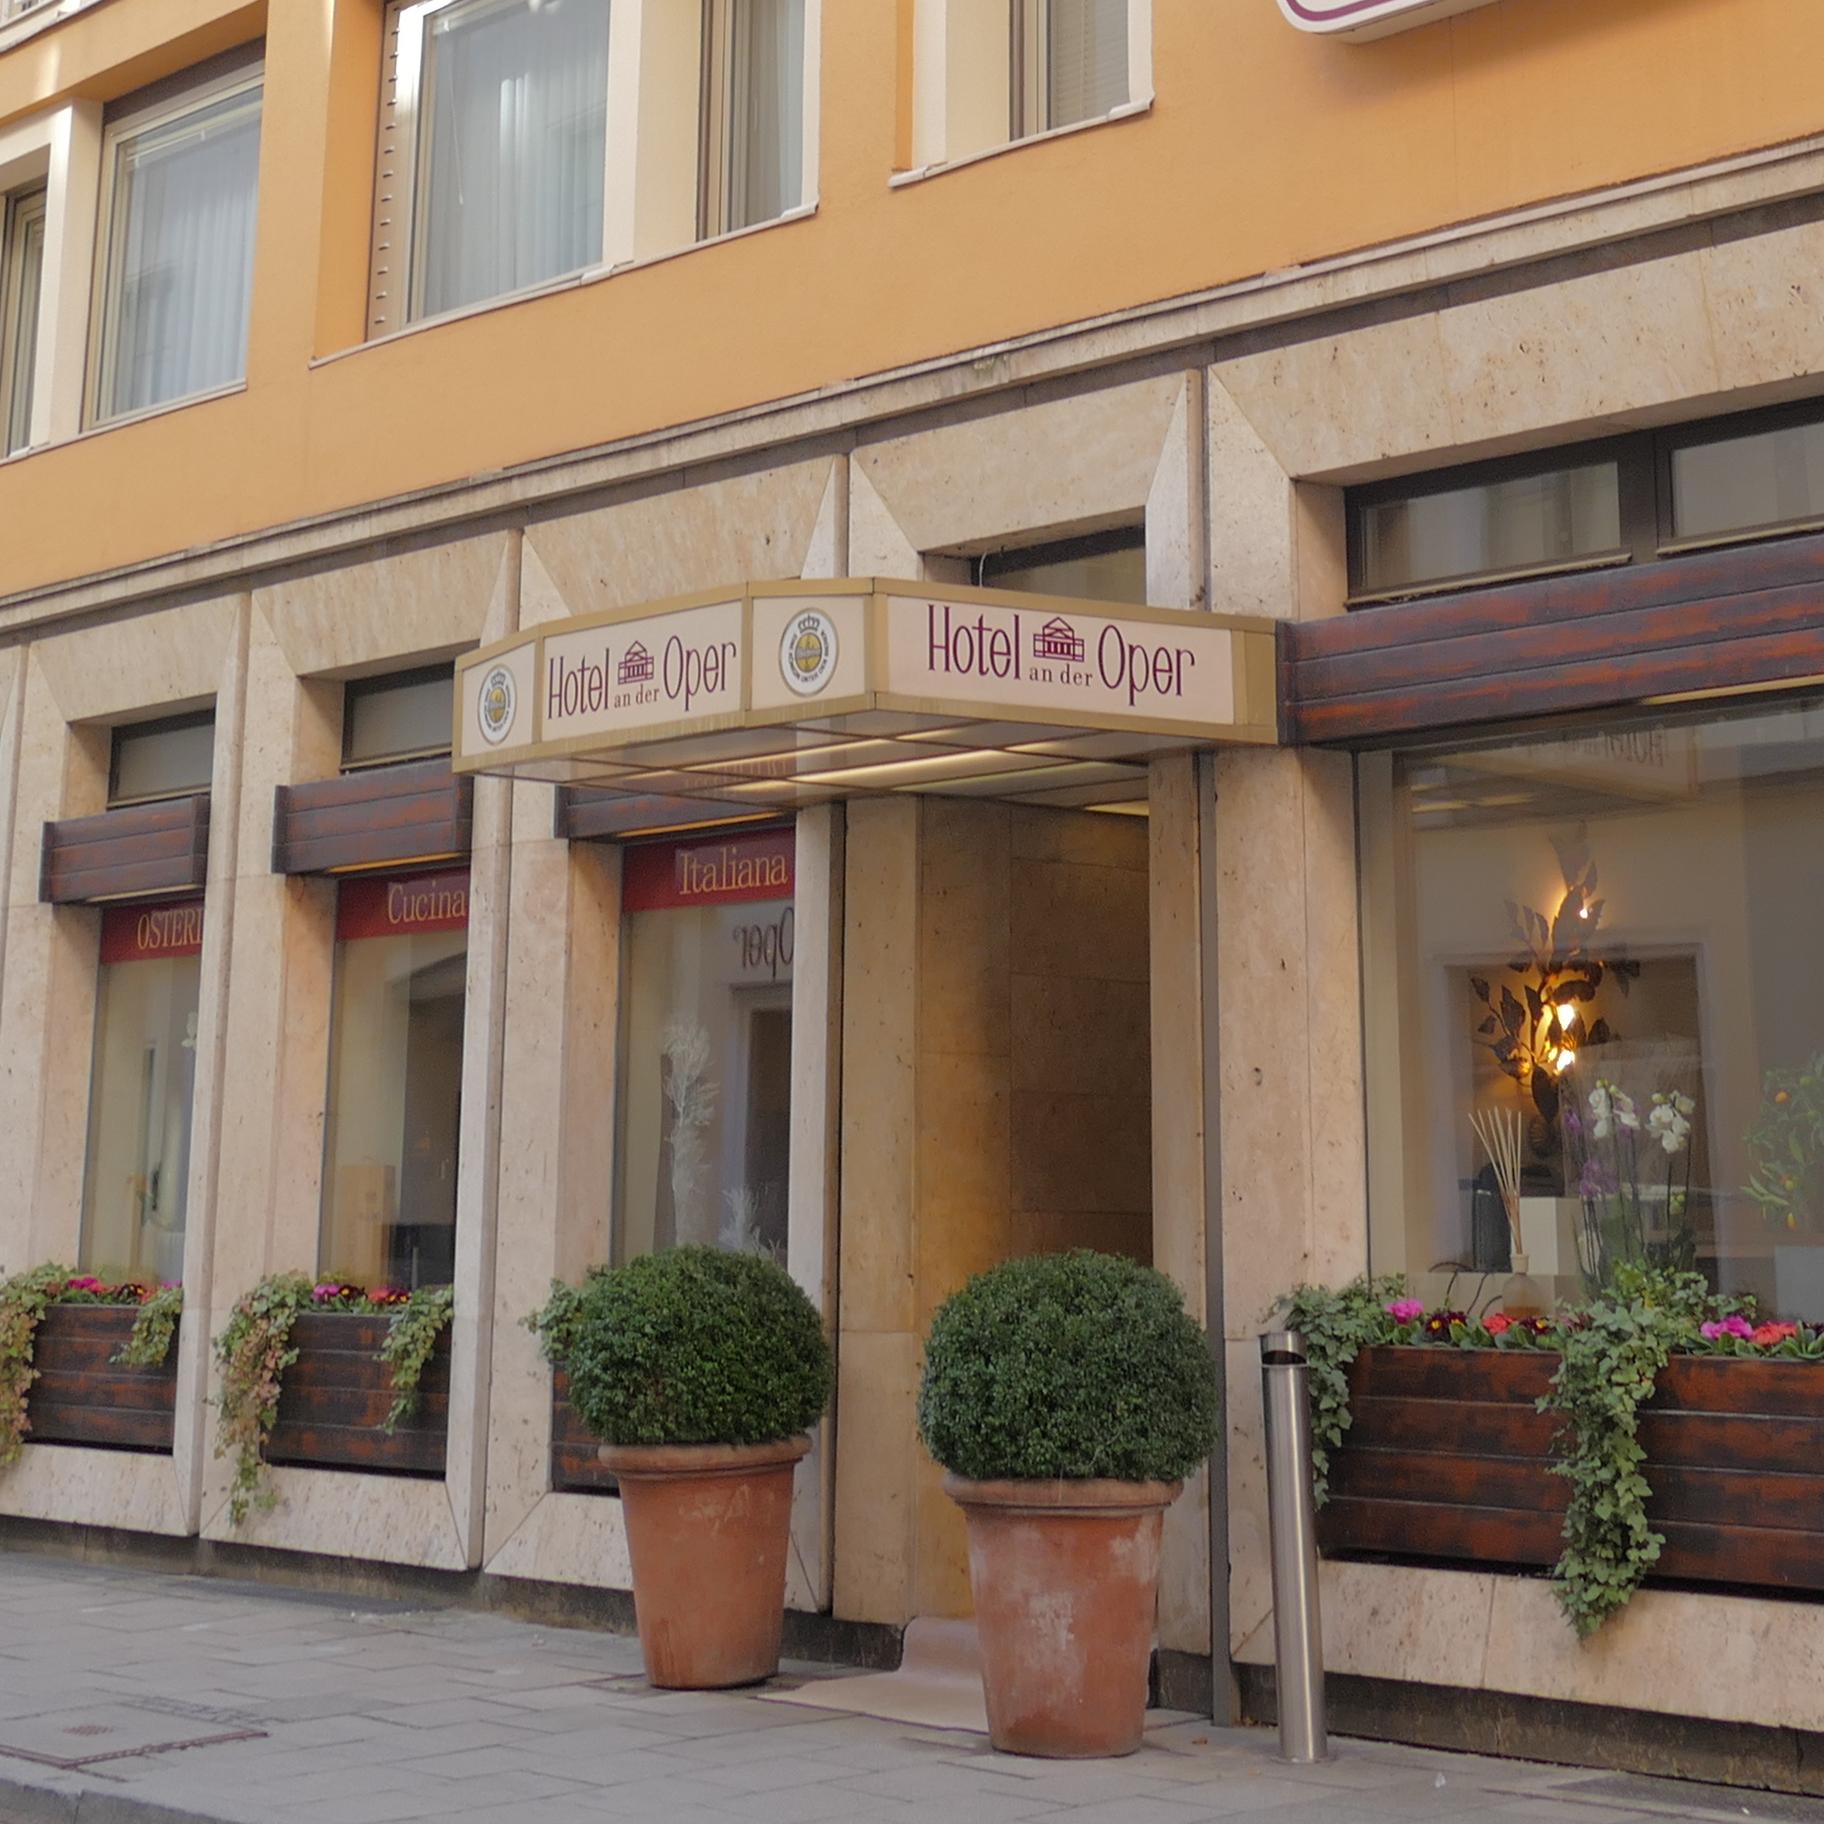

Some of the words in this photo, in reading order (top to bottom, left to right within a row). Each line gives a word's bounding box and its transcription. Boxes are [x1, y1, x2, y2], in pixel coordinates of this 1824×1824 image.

[548, 648, 610, 719] Hotel
[614, 694, 631, 708] an
[635, 684, 660, 705] der
[663, 635, 737, 712] Oper
[928, 604, 1021, 680] Hotel
[1029, 667, 1054, 683] an
[1060, 663, 1093, 687] der
[1098, 624, 1196, 706] Oper
[388, 879, 466, 924] Cucina
[679, 847, 789, 895] Italiana
